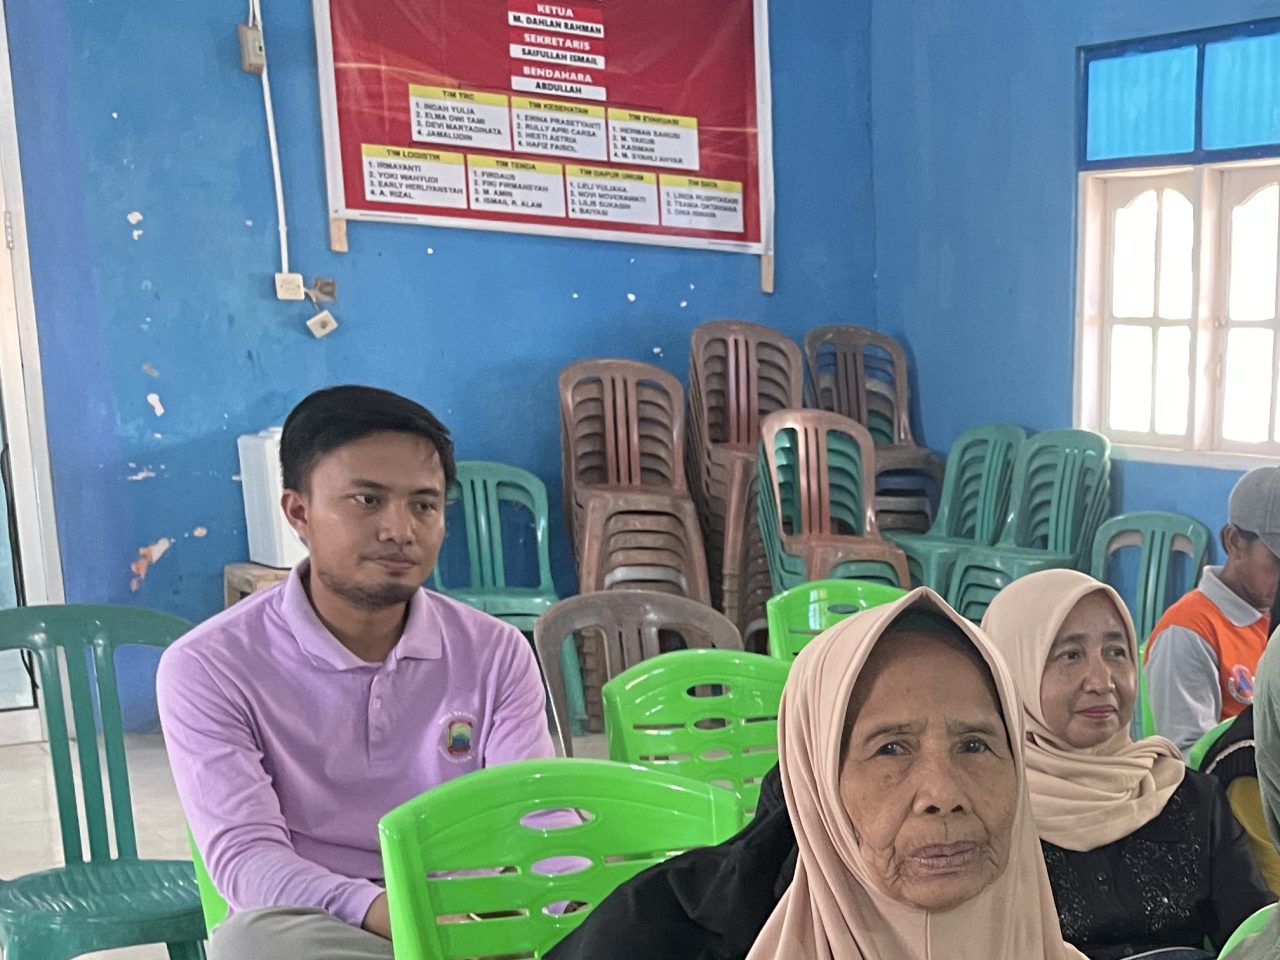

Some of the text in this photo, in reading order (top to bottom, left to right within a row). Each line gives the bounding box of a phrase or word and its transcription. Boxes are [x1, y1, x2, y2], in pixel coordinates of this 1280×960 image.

[537, 4, 574, 17] KETUA
[513, 15, 601, 34] M. DAHLAN RAHMAN
[524, 33, 590, 51] SEKRETARIS
[521, 48, 598, 65] SAIFULLAH ISMAIL
[523, 66, 592, 83] BENDAHARA
[535, 82, 582, 94] ABDULLAH
[442, 90, 457, 99] TIM
[424, 103, 449, 112] INDAH
[451, 106, 475, 115] YULIA
[529, 101, 541, 109] TIM
[425, 121, 444, 129] DEVI
[386, 149, 441, 161] TIM LOGISTIK
[377, 162, 421, 172] IRMAYANTI
[400, 174, 439, 183] WAHYUDI
